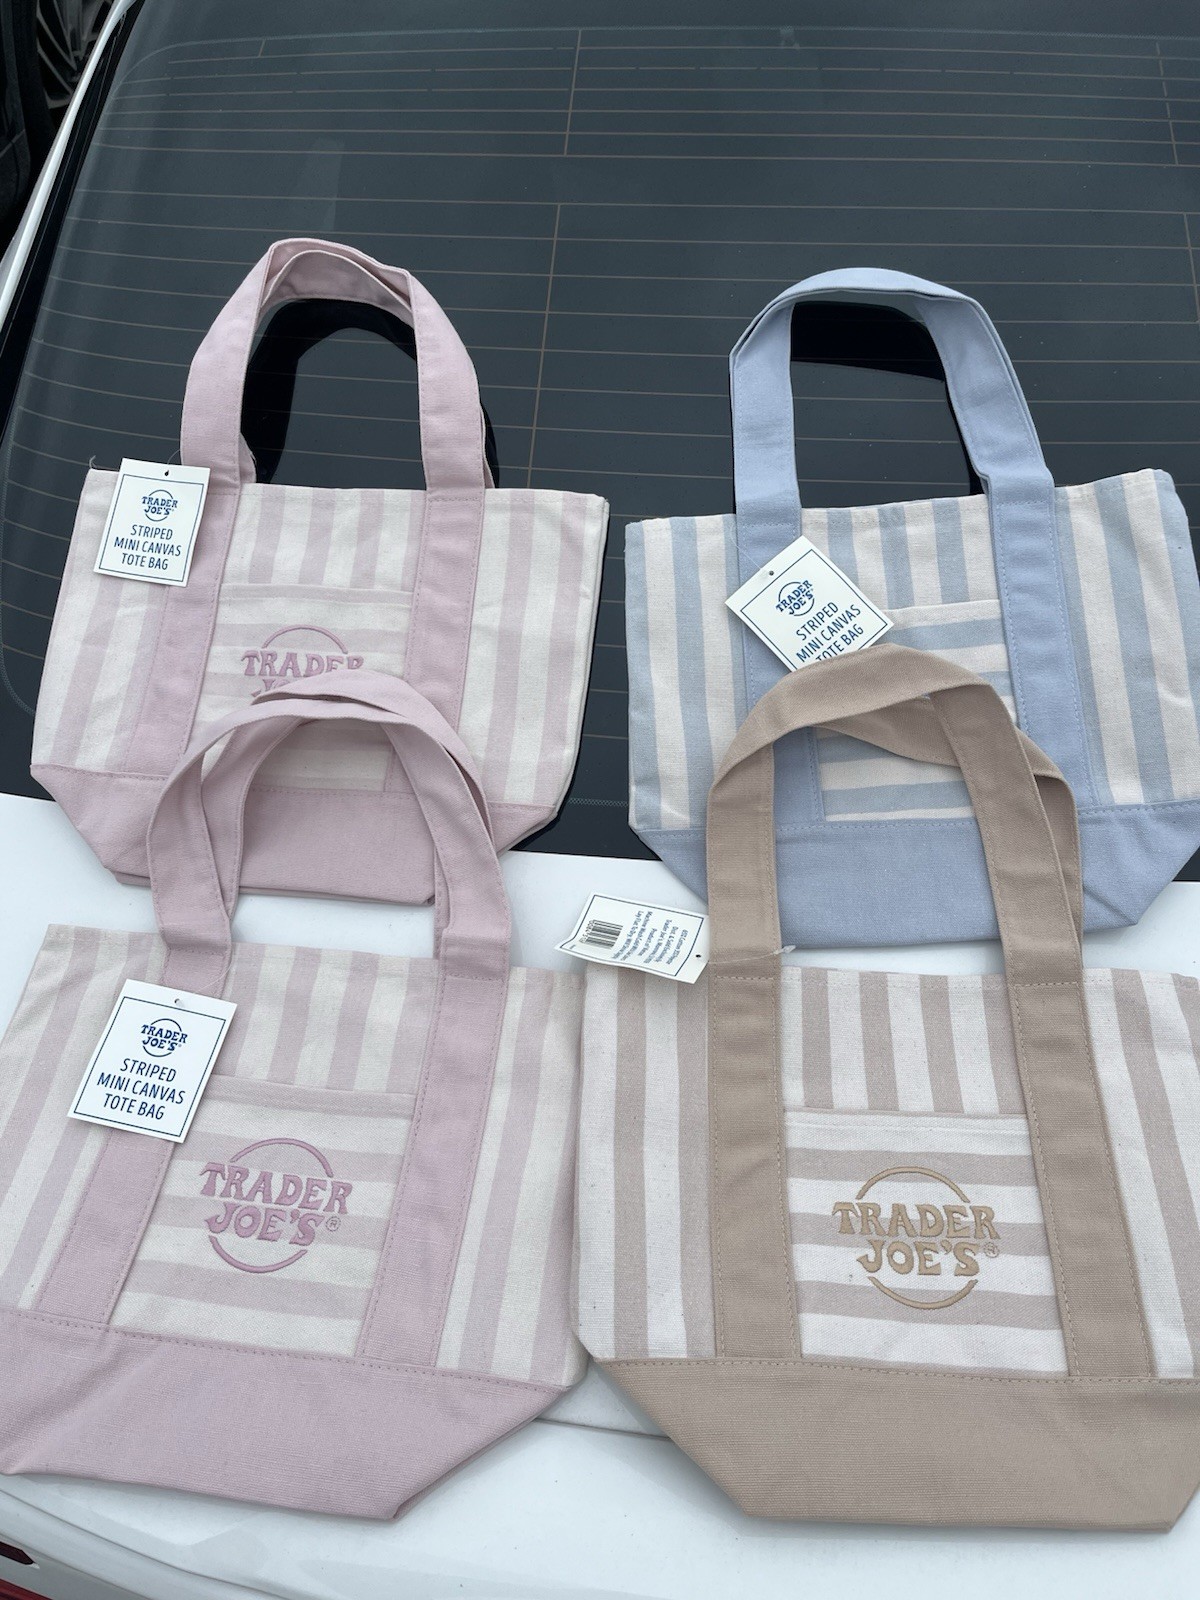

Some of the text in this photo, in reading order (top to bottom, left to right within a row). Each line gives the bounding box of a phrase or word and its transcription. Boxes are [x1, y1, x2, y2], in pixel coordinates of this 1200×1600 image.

[142, 496, 178, 508] TRADER
[144, 506, 172, 515] JOE'S
[131, 524, 173, 540] STRIPED
[114, 537, 181, 556] MINI CANVAS
[122, 553, 168, 570] TOTE BAG
[776, 580, 813, 612] TRADER
[788, 590, 814, 615] JOE'S
[796, 602, 839, 641] STRIPED
[796, 605, 861, 663] MINI CANVAS
[840, 624, 864, 646] BAG
[140, 1024, 188, 1044] TRADER
[142, 1036, 180, 1052] JOE'S
[120, 1058, 177, 1082] STRIPED
[96, 1072, 186, 1105] MINI CANVAS
[103, 1093, 166, 1120] TOTE BAG
[199, 1161, 353, 1214] TRADER
[832, 1201, 1001, 1239] TRADER
